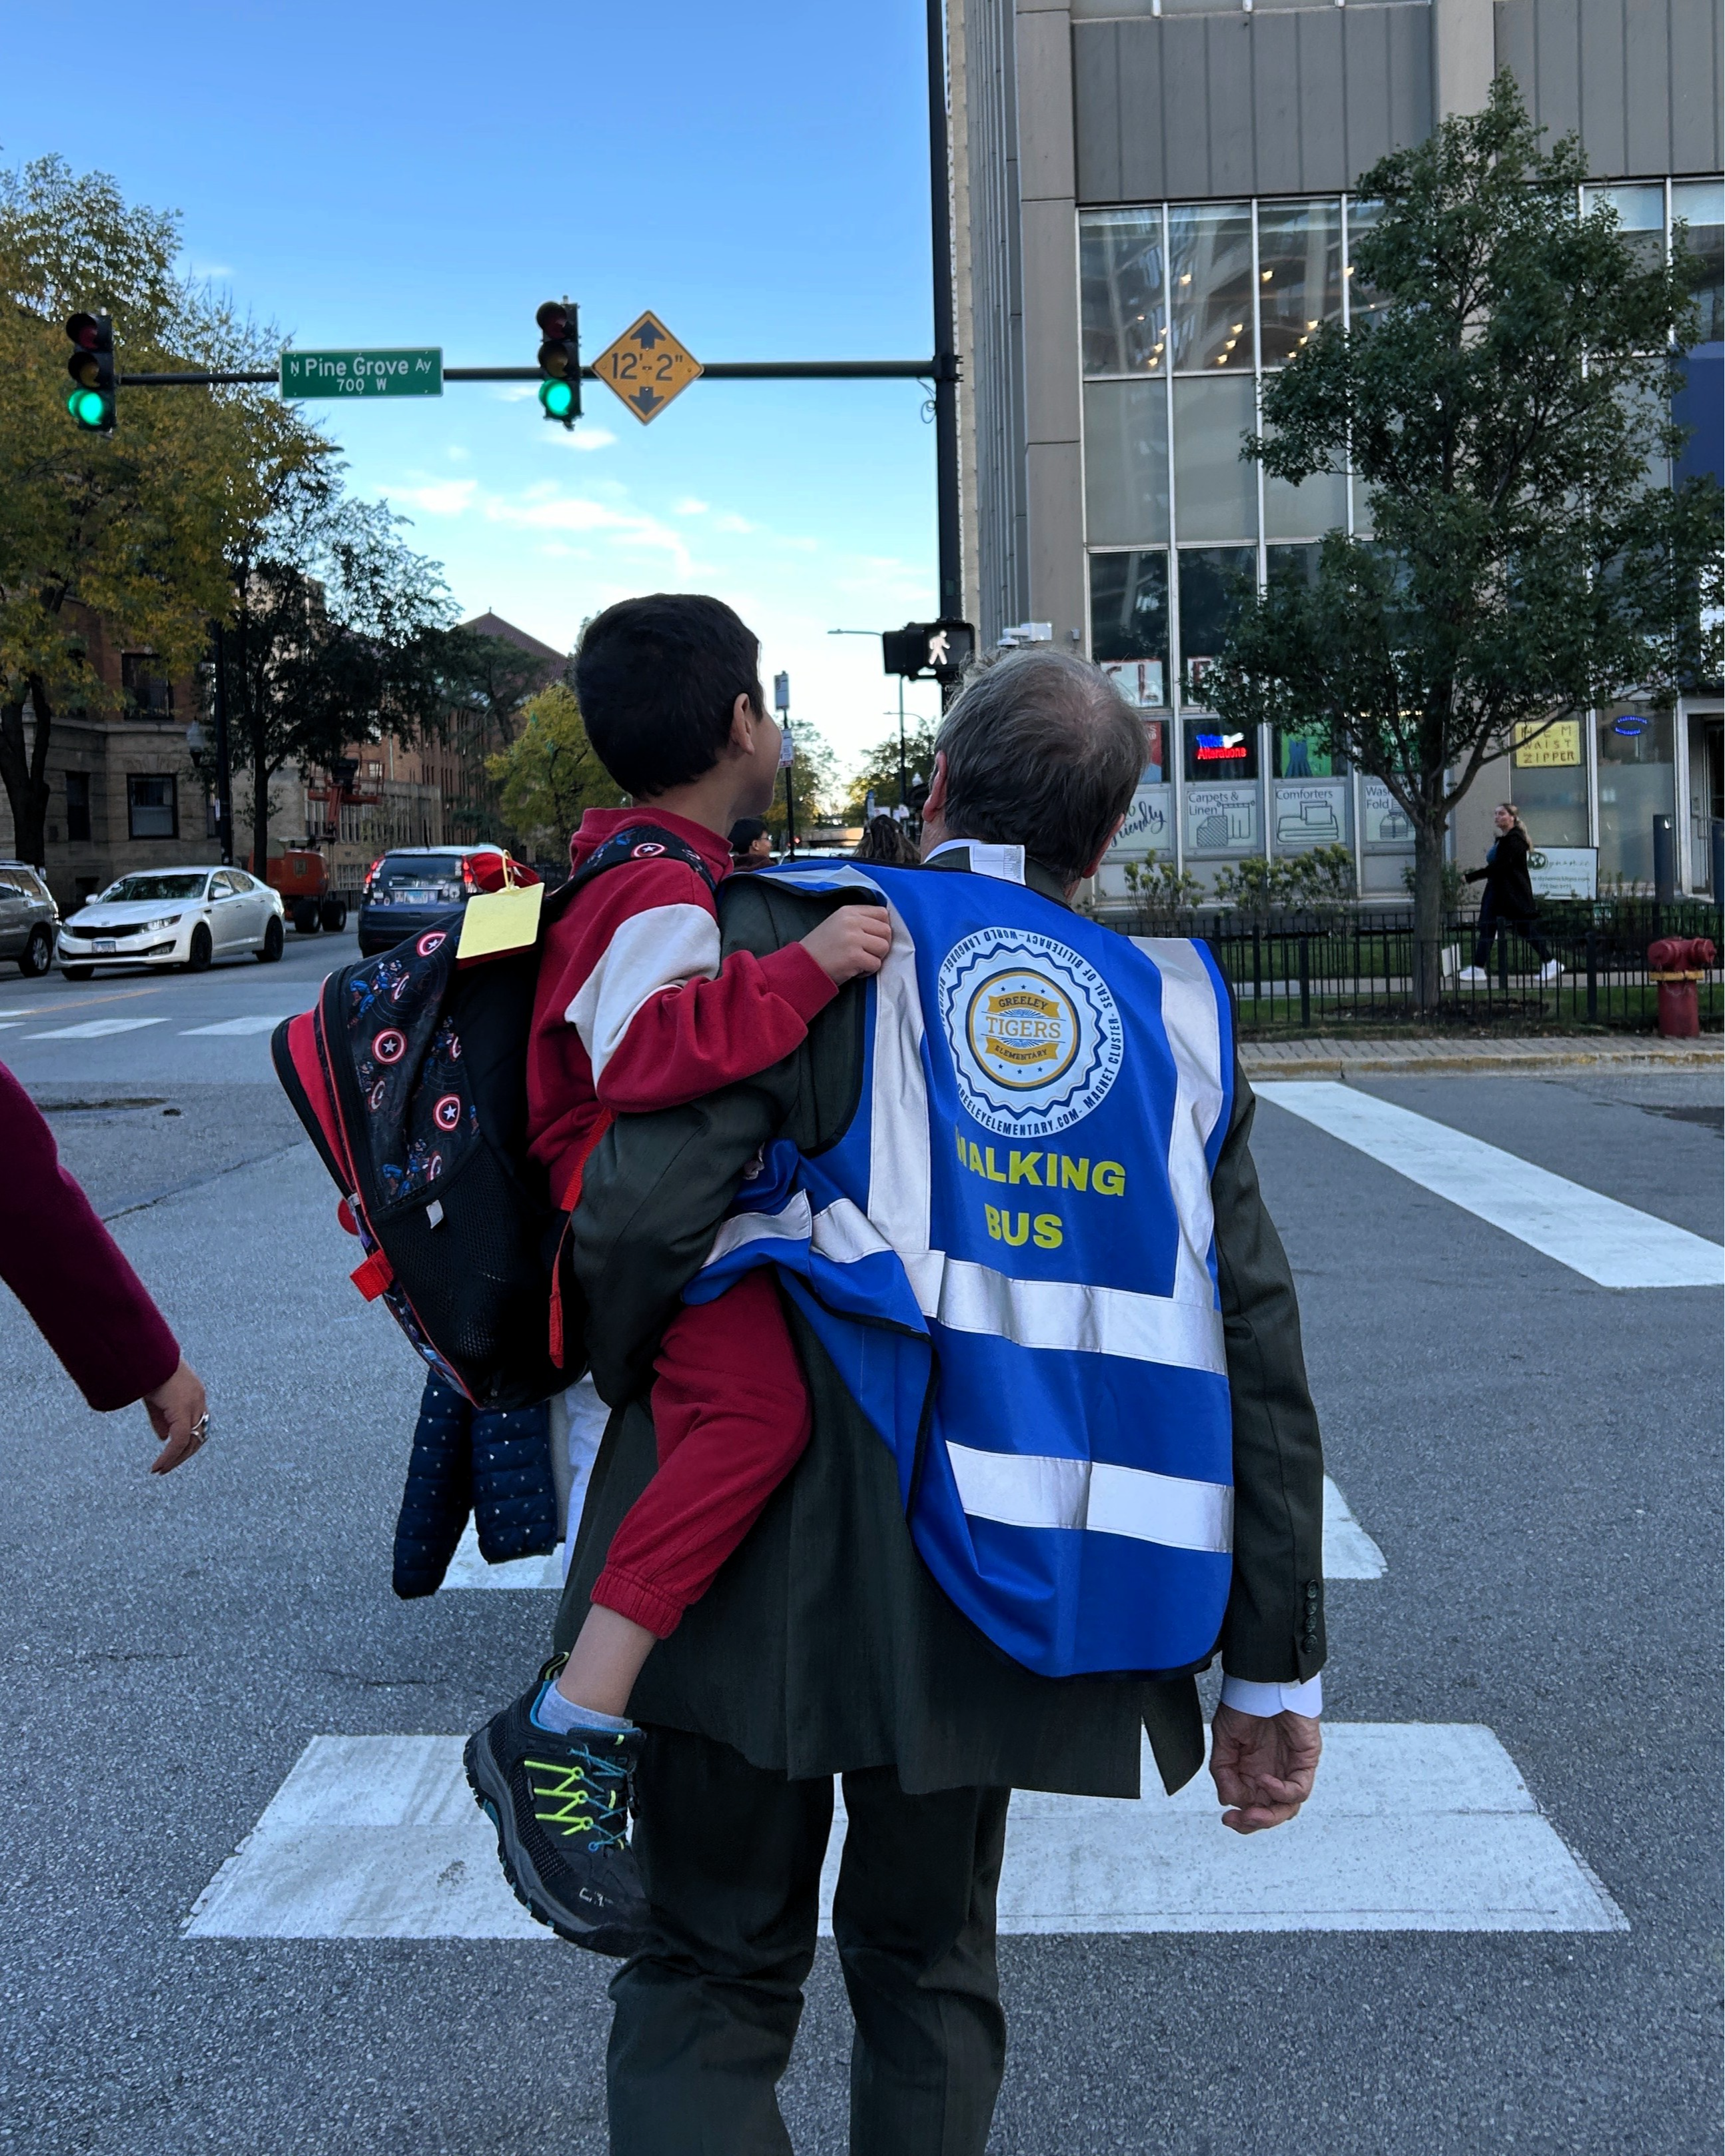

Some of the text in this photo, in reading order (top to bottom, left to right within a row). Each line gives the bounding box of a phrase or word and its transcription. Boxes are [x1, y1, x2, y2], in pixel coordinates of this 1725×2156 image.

[290, 357, 433, 377] N Pine Grove Av
[336, 378, 386, 393] 700 W
[1523, 751, 1575, 764] ZIPPER
[1188, 792, 1239, 805] Carpets &
[1275, 789, 1333, 800] Comforters
[1189, 805, 1218, 816] Linen
[1367, 799, 1389, 809] Fold
[1082, 966, 1097, 983] OF
[999, 996, 1049, 1010] GREELEY
[1095, 983, 1113, 1009] SEAL
[986, 1016, 1061, 1039] TIGERS
[995, 1045, 1048, 1061] ELEMENTARY
[1083, 1067, 1115, 1108] MAGNET
[984, 1203, 1063, 1249] BUS
